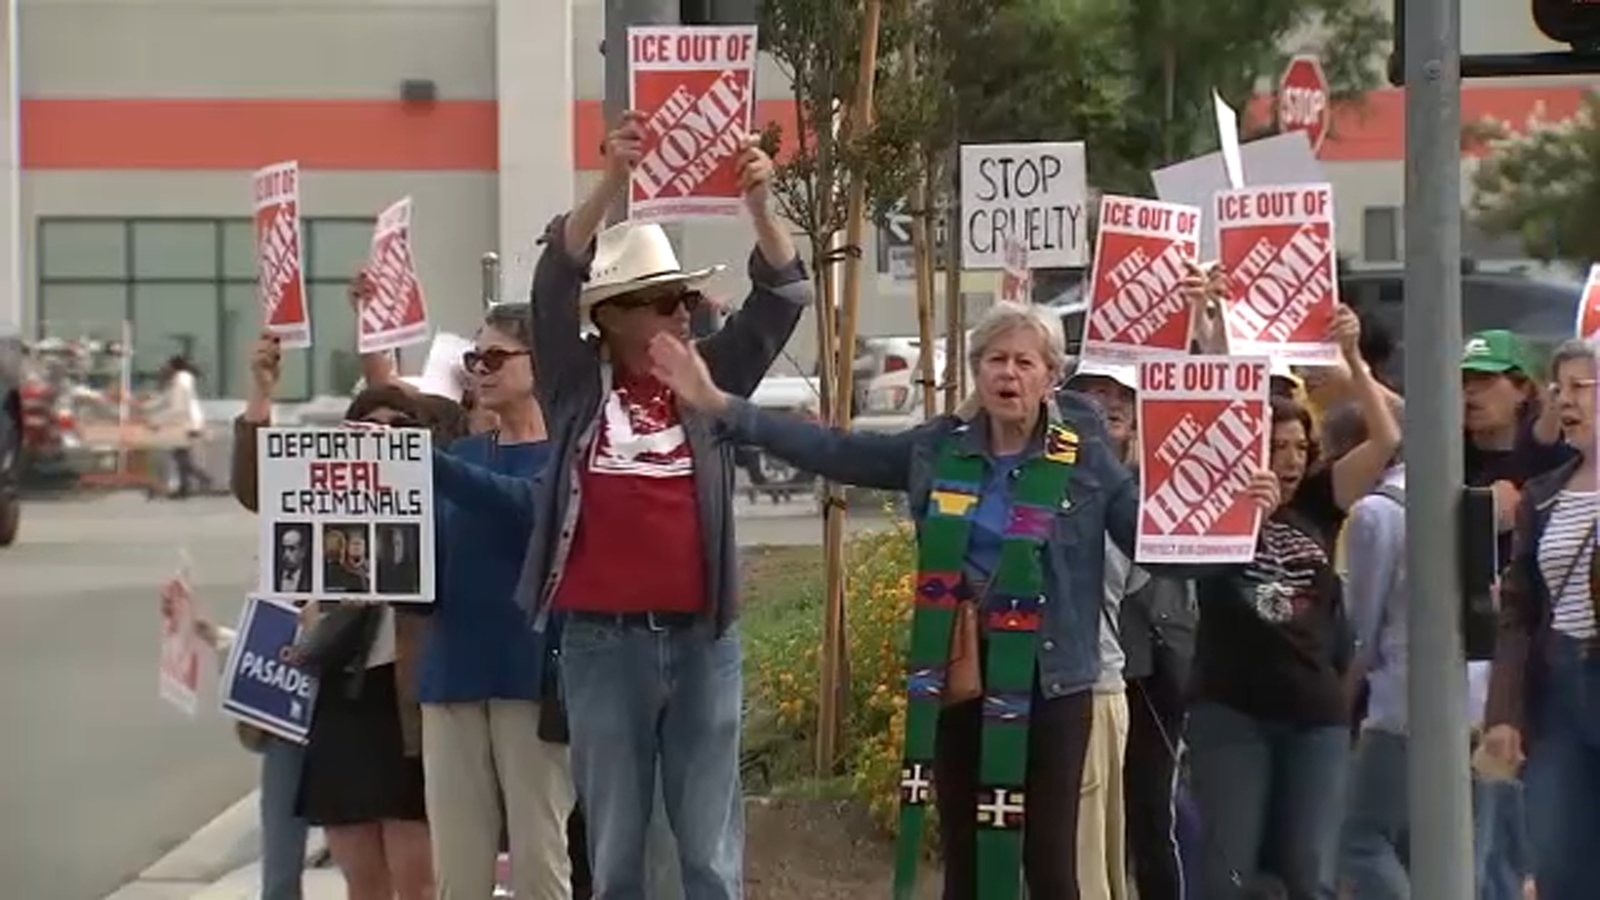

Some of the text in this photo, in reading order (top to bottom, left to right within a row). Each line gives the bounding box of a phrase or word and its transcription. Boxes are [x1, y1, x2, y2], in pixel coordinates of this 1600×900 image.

[633, 34, 753, 63] ICE OUT OF
[646, 84, 696, 136] THE
[1281, 88, 1326, 126] STOP
[631, 69, 748, 198] HOME
[976, 154, 1061, 201] STOP
[1103, 202, 1197, 235] ICE OUT OF
[1217, 190, 1328, 221] ICE OUT OF
[1104, 246, 1151, 289] THE
[1228, 224, 1332, 340] HOME
[1230, 236, 1278, 286] THE
[1127, 284, 1188, 345] DEPO
[1266, 266, 1332, 343] DEPOT
[1140, 362, 1265, 391] ICE OUT OF
[267, 432, 421, 461] DEPORT THE
[1154, 412, 1203, 466] THE
[310, 462, 391, 493] REAL
[1144, 400, 1263, 535] HOME
[281, 490, 422, 516] CRIMINALS
[240, 652, 311, 698] PASADE
